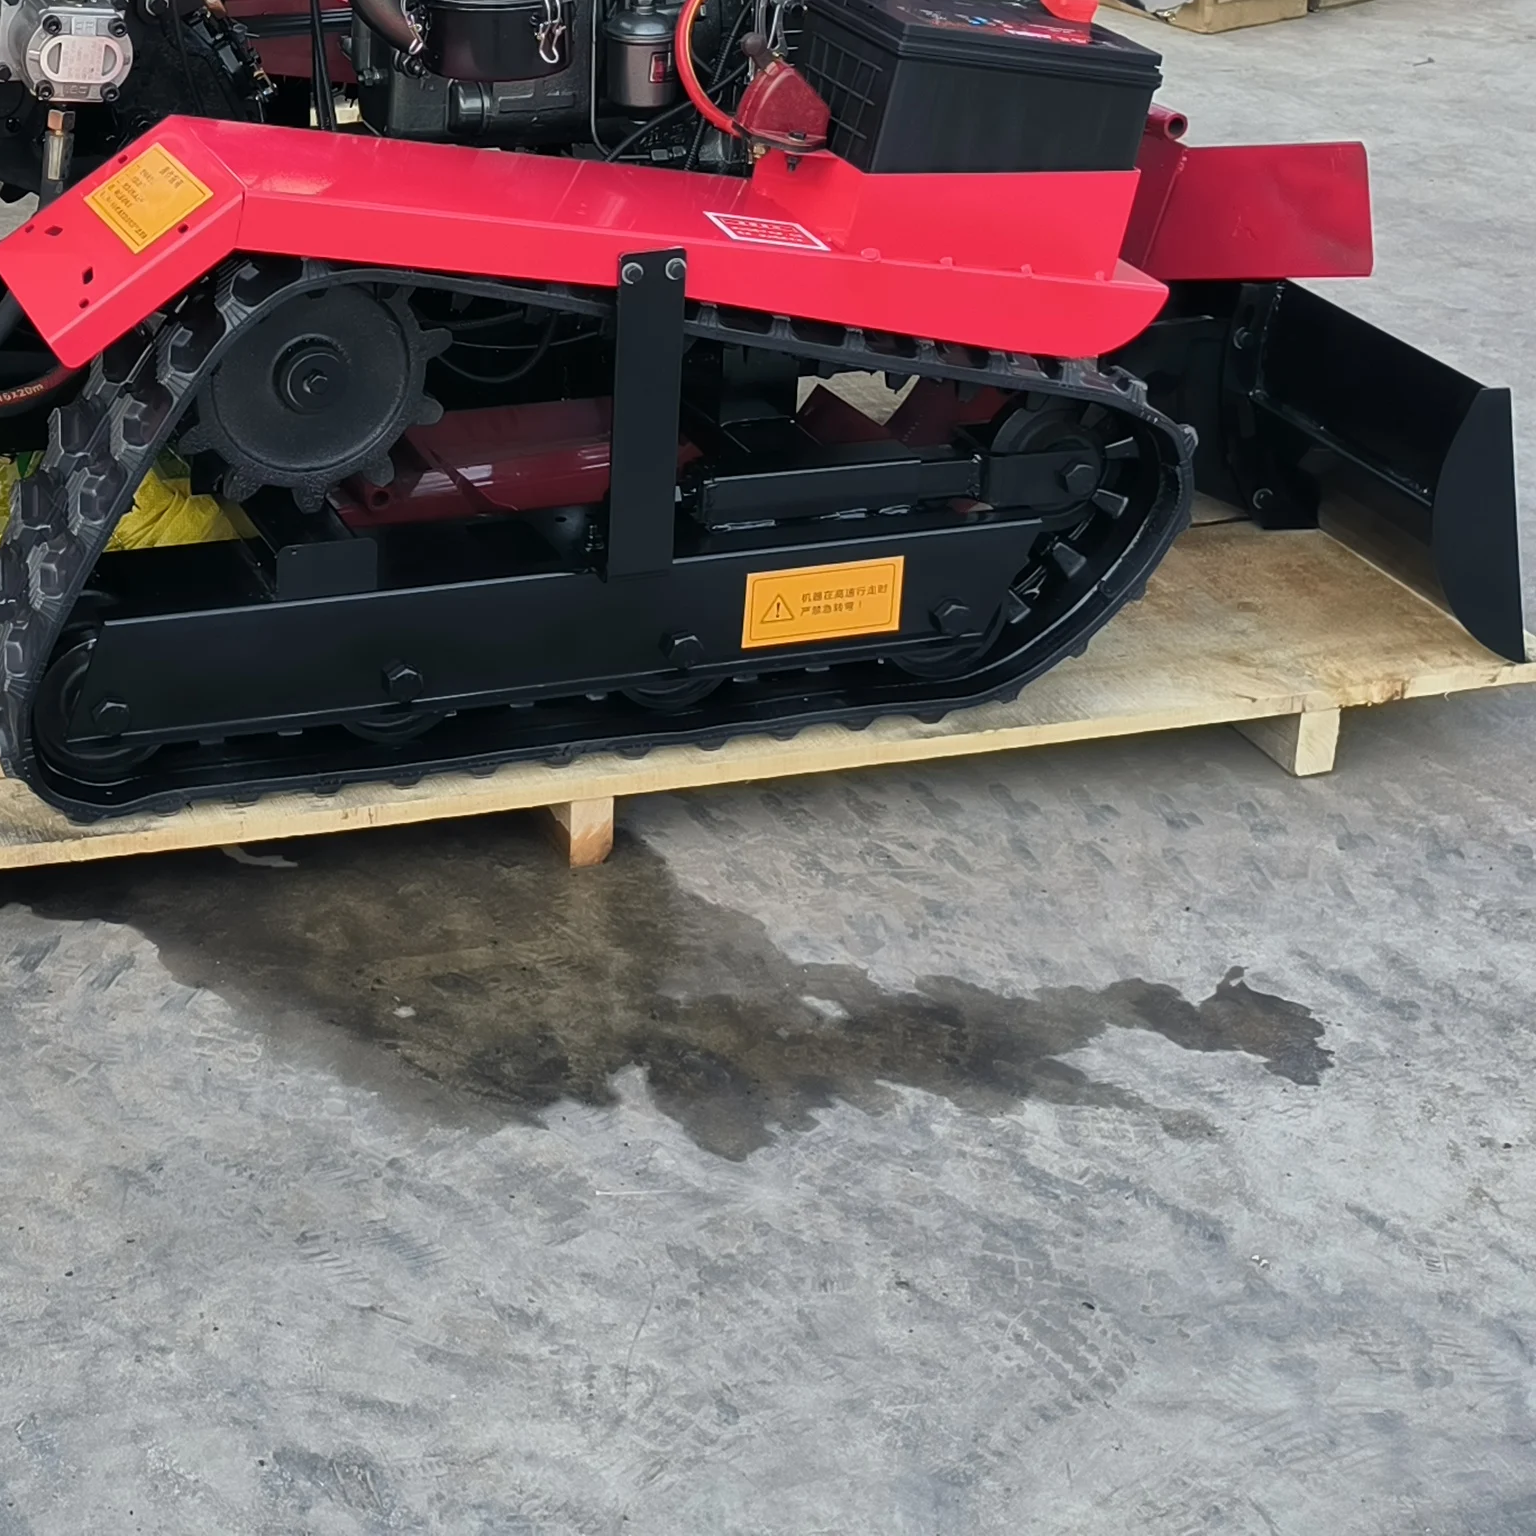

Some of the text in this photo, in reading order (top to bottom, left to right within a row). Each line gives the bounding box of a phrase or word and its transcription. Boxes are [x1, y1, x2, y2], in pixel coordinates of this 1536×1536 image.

[801, 583, 888, 603] 机器在高速行走时
